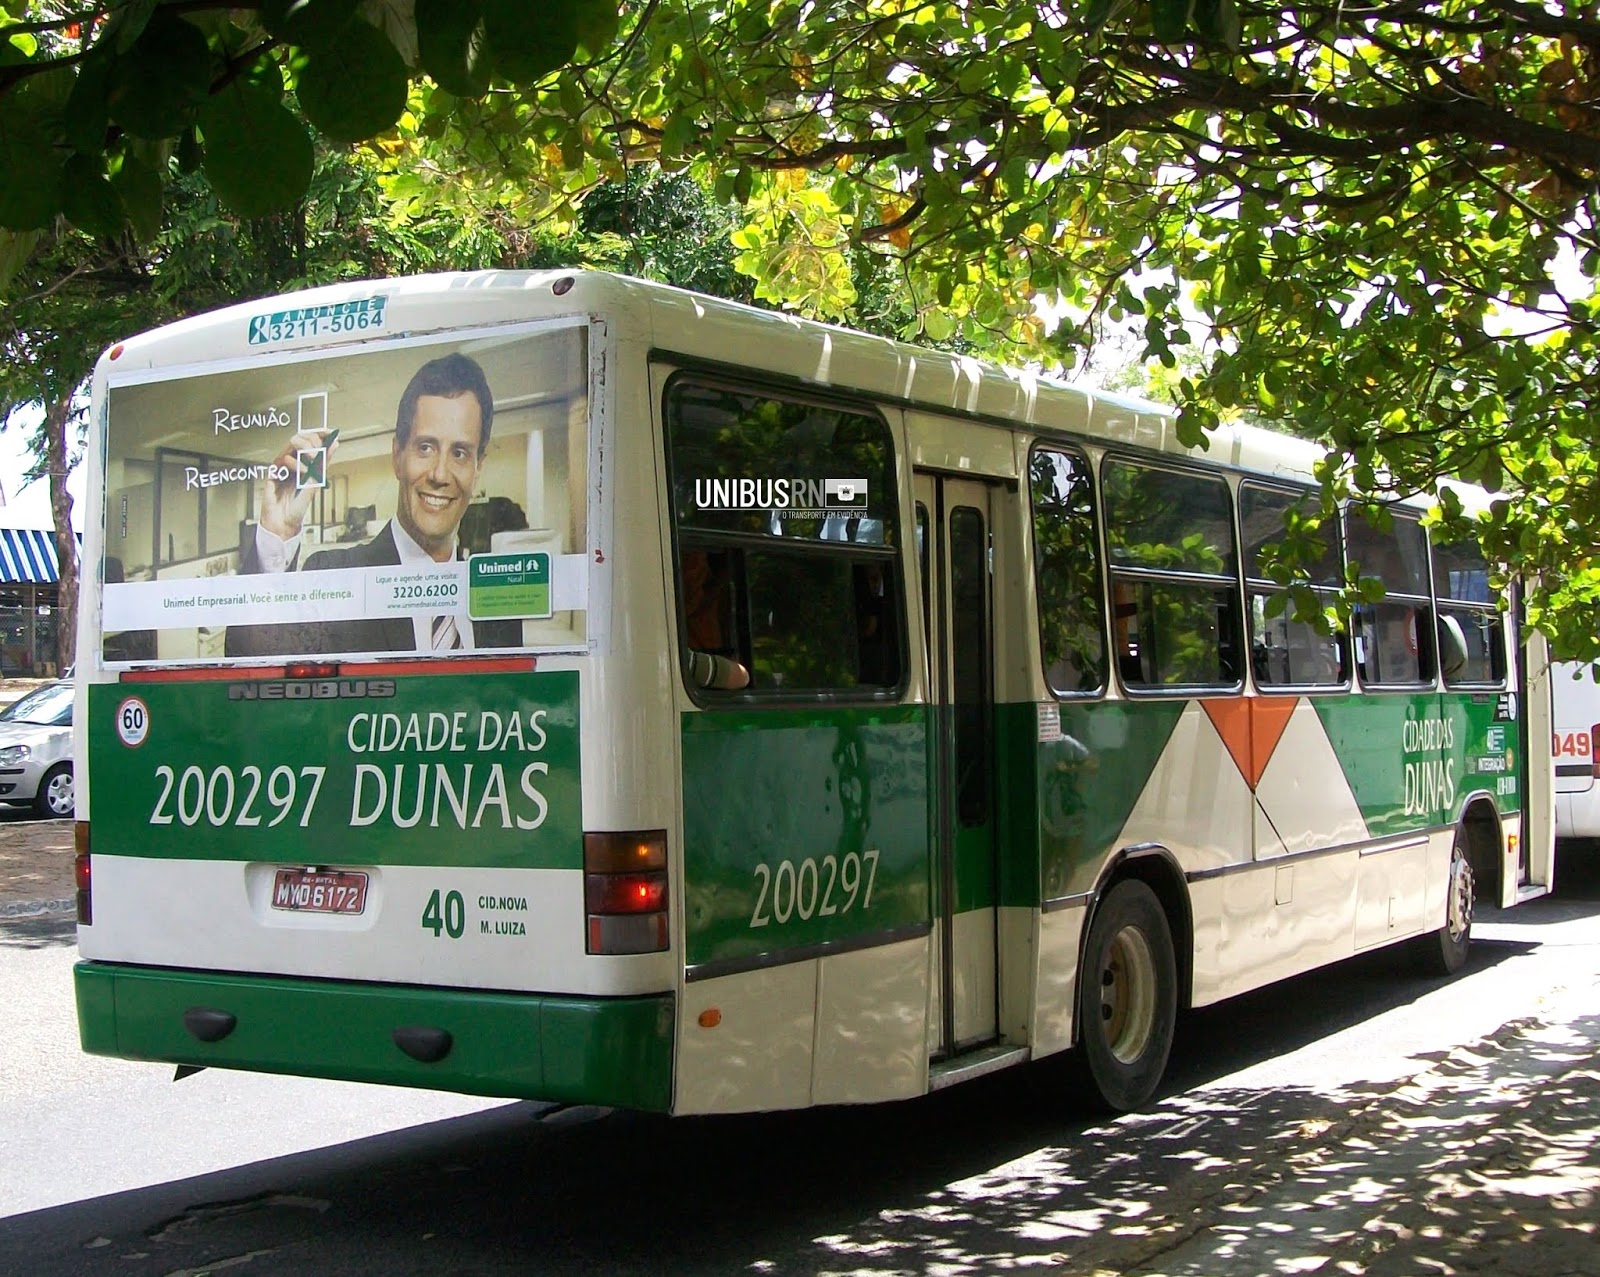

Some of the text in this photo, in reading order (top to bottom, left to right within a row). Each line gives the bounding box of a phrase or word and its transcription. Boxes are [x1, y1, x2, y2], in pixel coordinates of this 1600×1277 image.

[282, 299, 376, 323] ANUNCIE
[271, 310, 383, 341] 3211-5064
[399, 573, 423, 583] agende
[477, 560, 522, 574] Unimed
[163, 597, 195, 608] Unimed
[197, 594, 248, 608] Empresarial.
[250, 592, 272, 604] Você
[274, 593, 299, 602] sente
[309, 589, 354, 601] diferença.
[393, 583, 458, 599] 3220.6200
[228, 680, 397, 700] NEOBUS
[123, 708, 143, 730] 60
[346, 709, 548, 753] CIDADE DAS
[1402, 719, 1435, 753] CIDADE
[1436, 717, 1454, 751] DAS
[148, 764, 327, 828] 200297
[348, 761, 549, 831] DUNAS
[1404, 758, 1454, 816] DUNAS
[749, 850, 880, 928] 200297
[421, 888, 466, 939] 40
[478, 895, 528, 912] CID.NOVA
[480, 920, 526, 936] M. LUIZA
